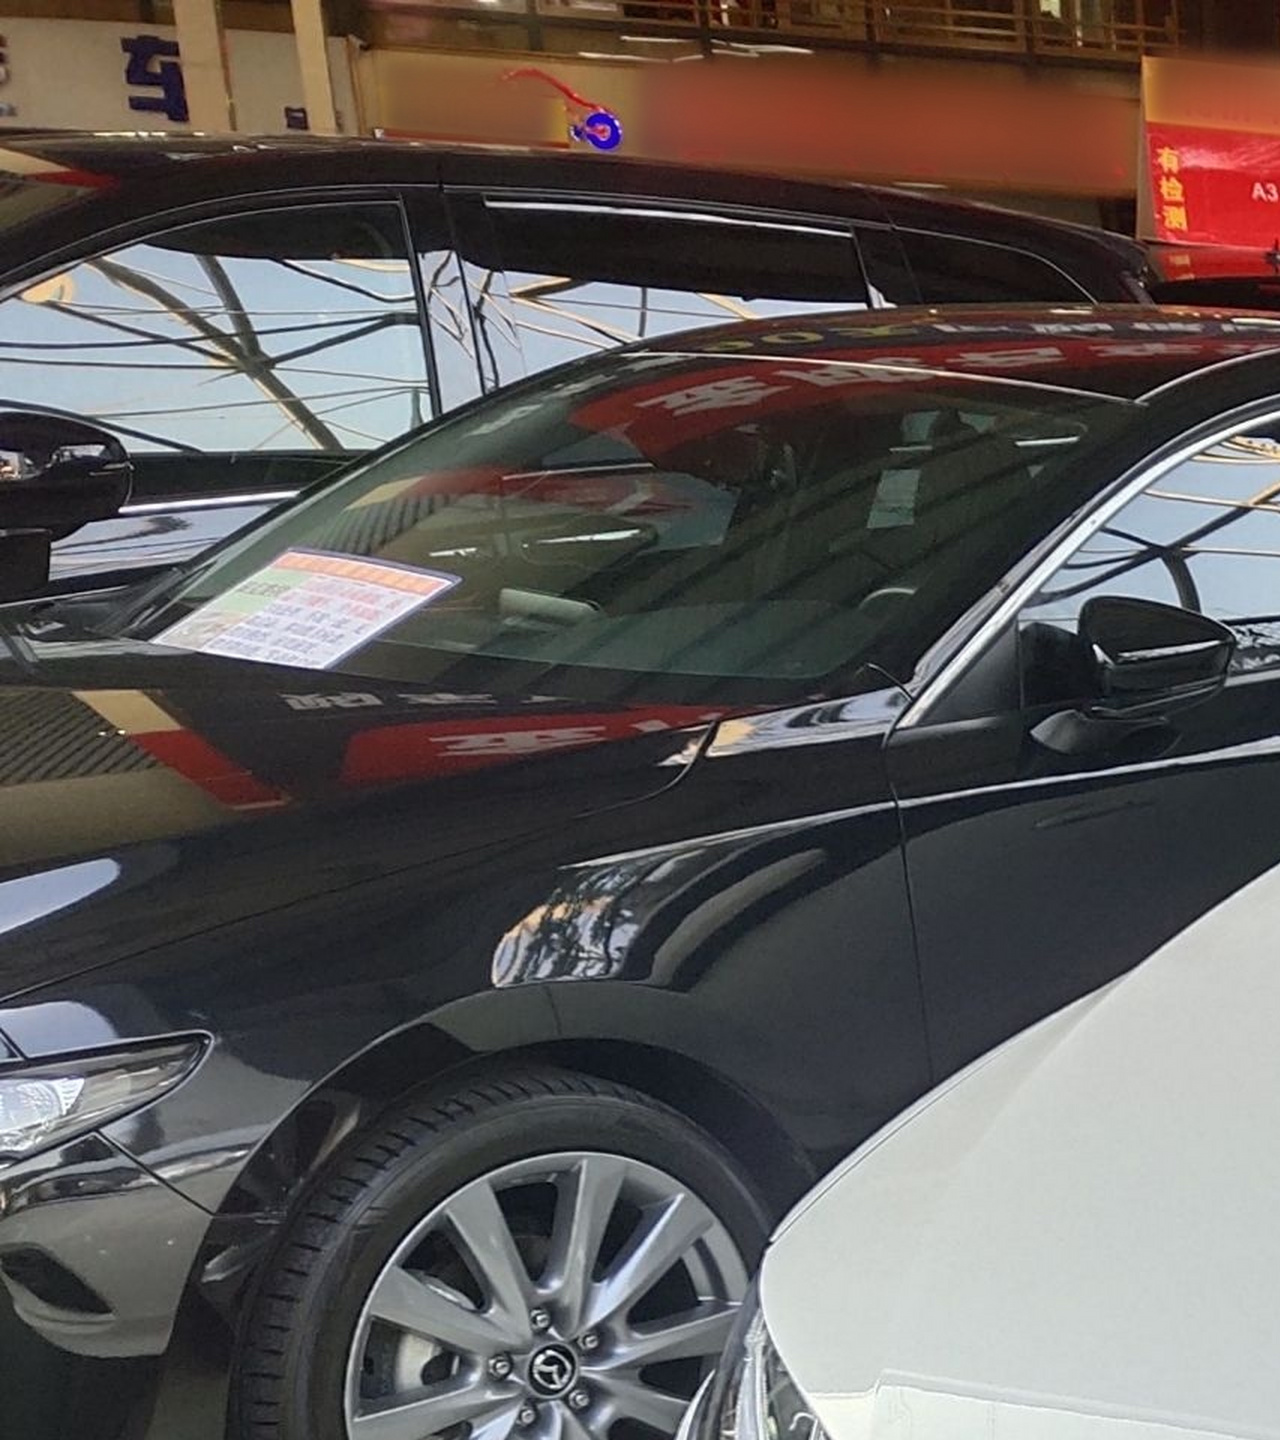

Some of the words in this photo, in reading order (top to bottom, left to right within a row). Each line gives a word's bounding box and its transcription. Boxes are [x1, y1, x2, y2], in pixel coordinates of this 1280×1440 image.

[1156, 146, 1189, 233] 有检测
[1251, 182, 1279, 203] A3
